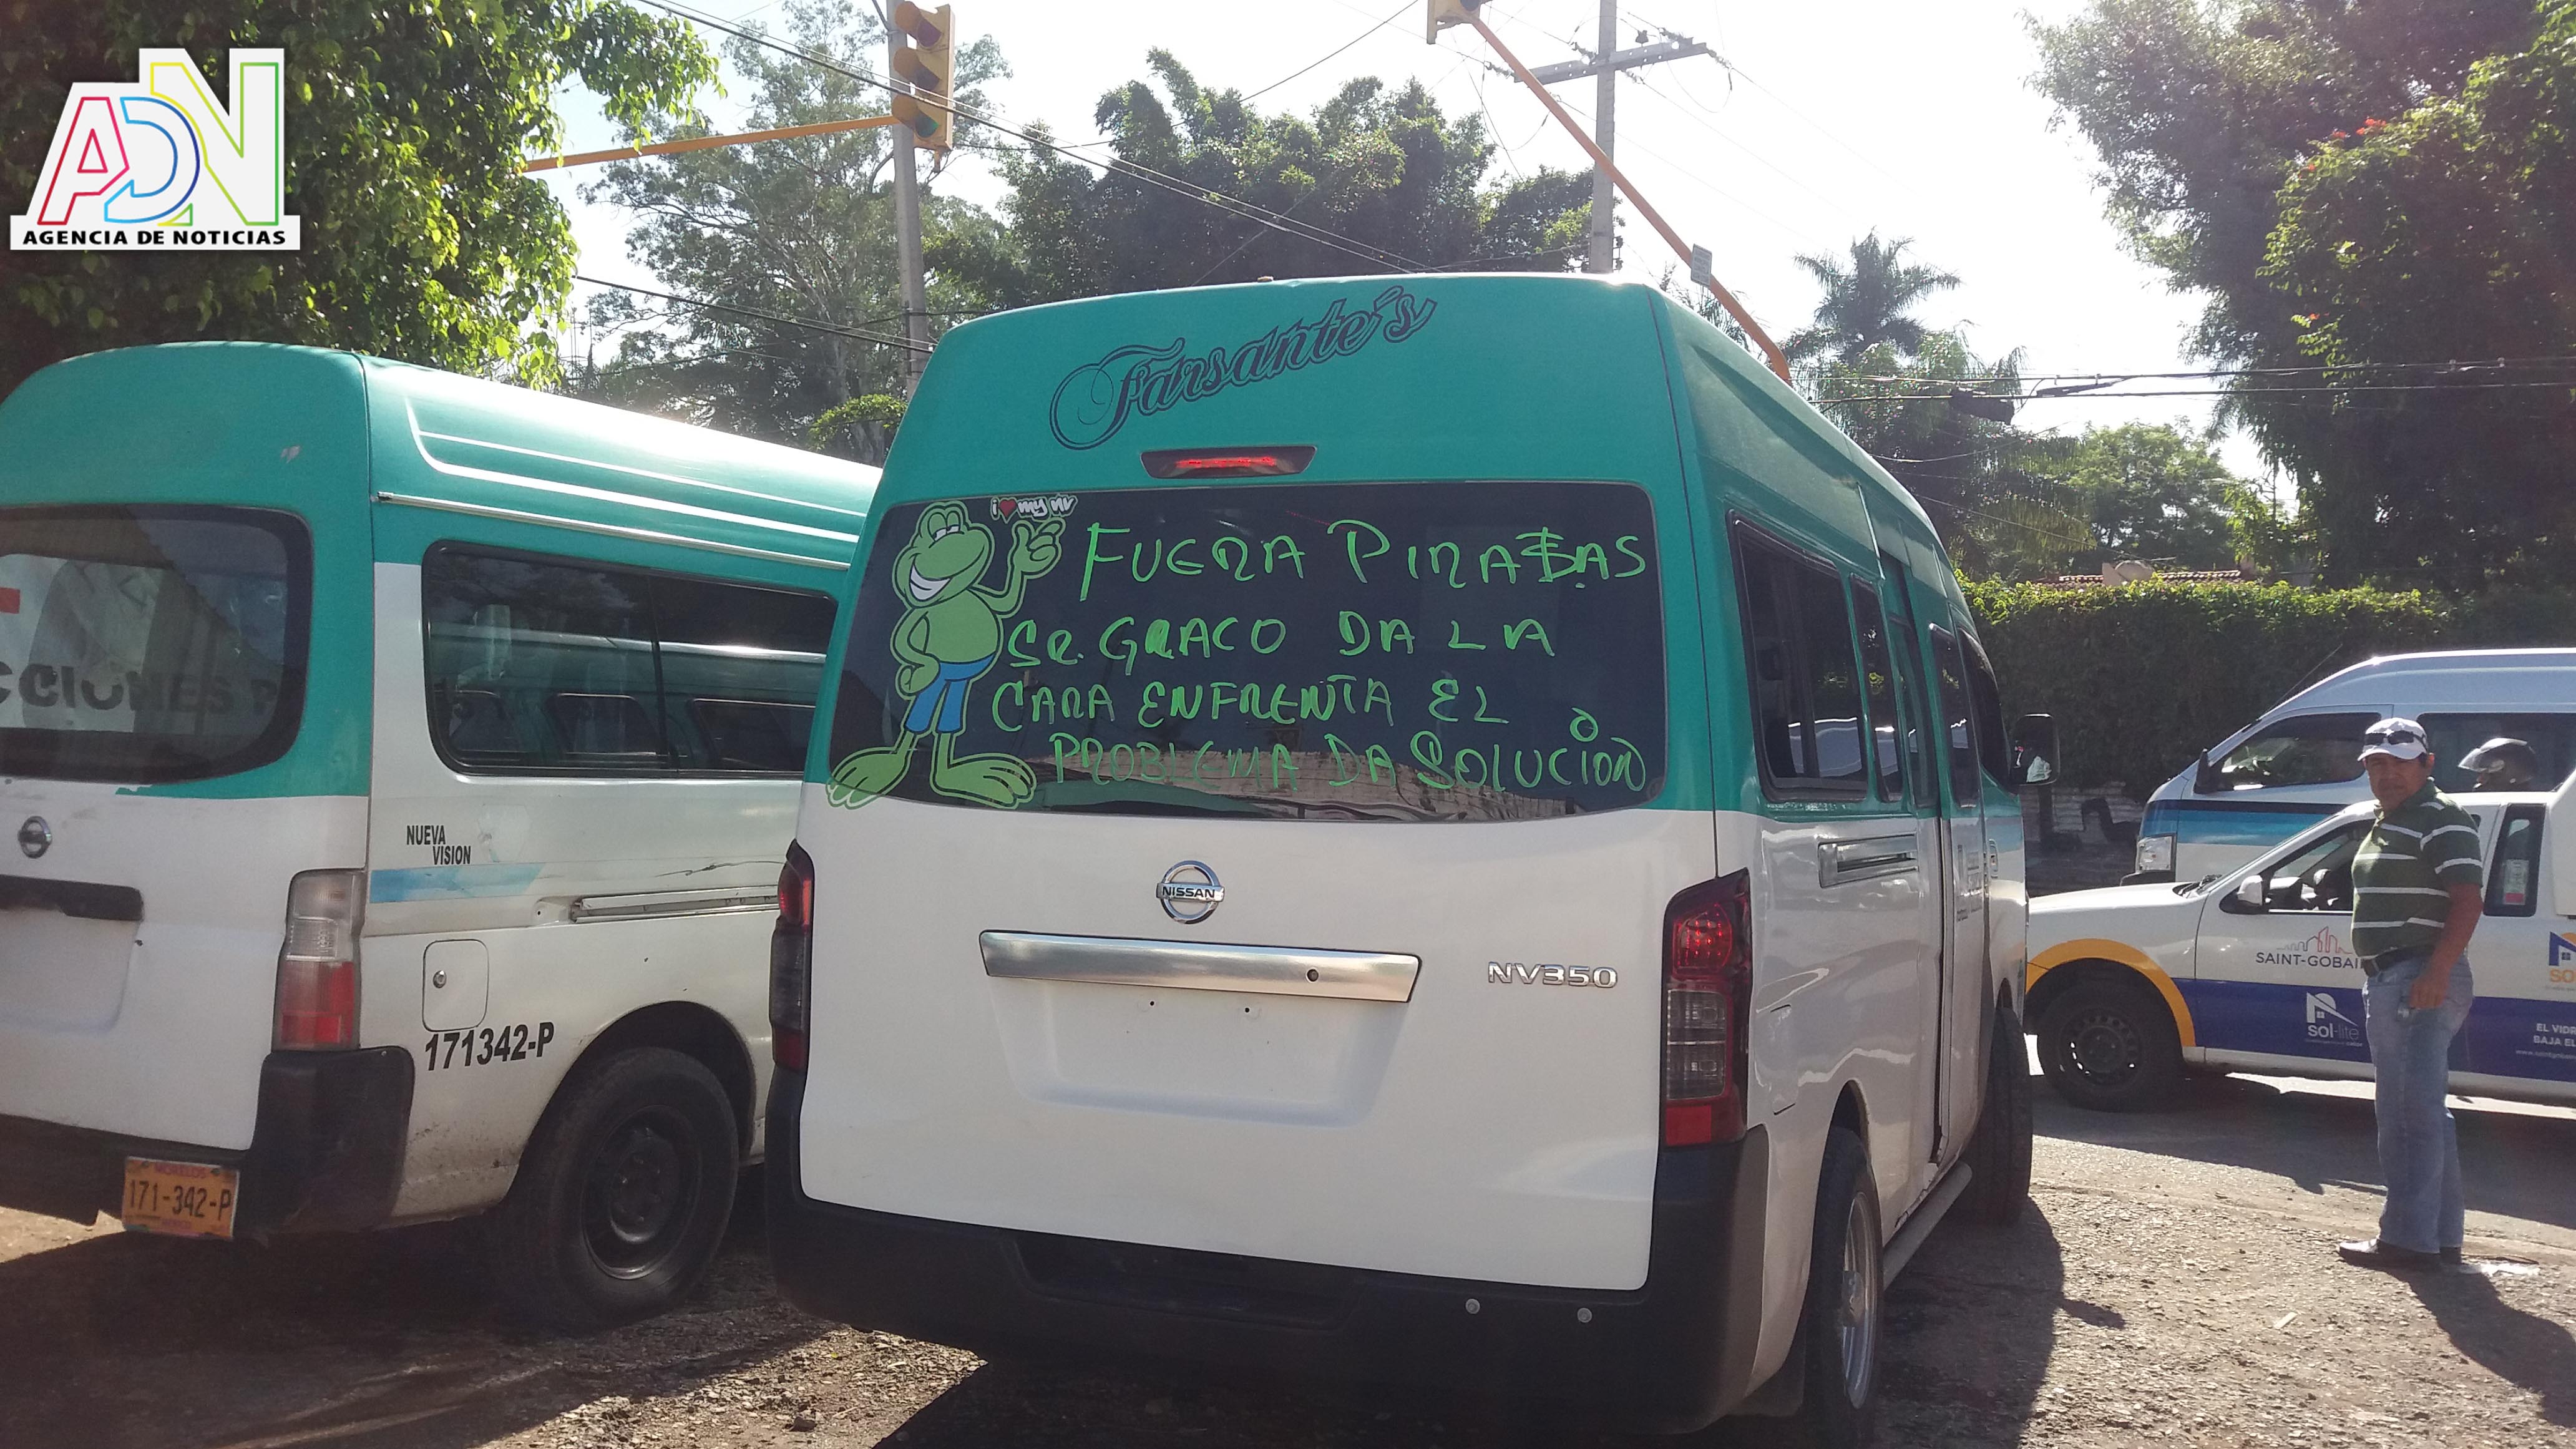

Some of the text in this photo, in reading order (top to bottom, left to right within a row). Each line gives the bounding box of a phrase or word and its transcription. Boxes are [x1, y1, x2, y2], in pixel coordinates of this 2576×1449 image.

[1018, 499, 1048, 517] my
[1080, 522, 1305, 601] FUERA
[1100, 617, 1286, 675] GRACO
[1339, 611, 1415, 656] DA
[1448, 619, 1554, 656] LA
[992, 675, 1508, 731] CARA ENFRENTA EL
[1049, 733, 1297, 792] PROBLEMA
[1325, 734, 1396, 787] DA
[406, 825, 446, 845] NUEVA
[432, 846, 471, 865] VISION
[1163, 886, 1215, 898] NISSAN
[1488, 961, 1617, 988] NV350
[2534, 1035, 2562, 1045] BAJA
[2536, 1023, 2549, 1032] EL
[425, 1022, 555, 1071] 171342-P
[129, 1179, 232, 1220] 171-342-P
